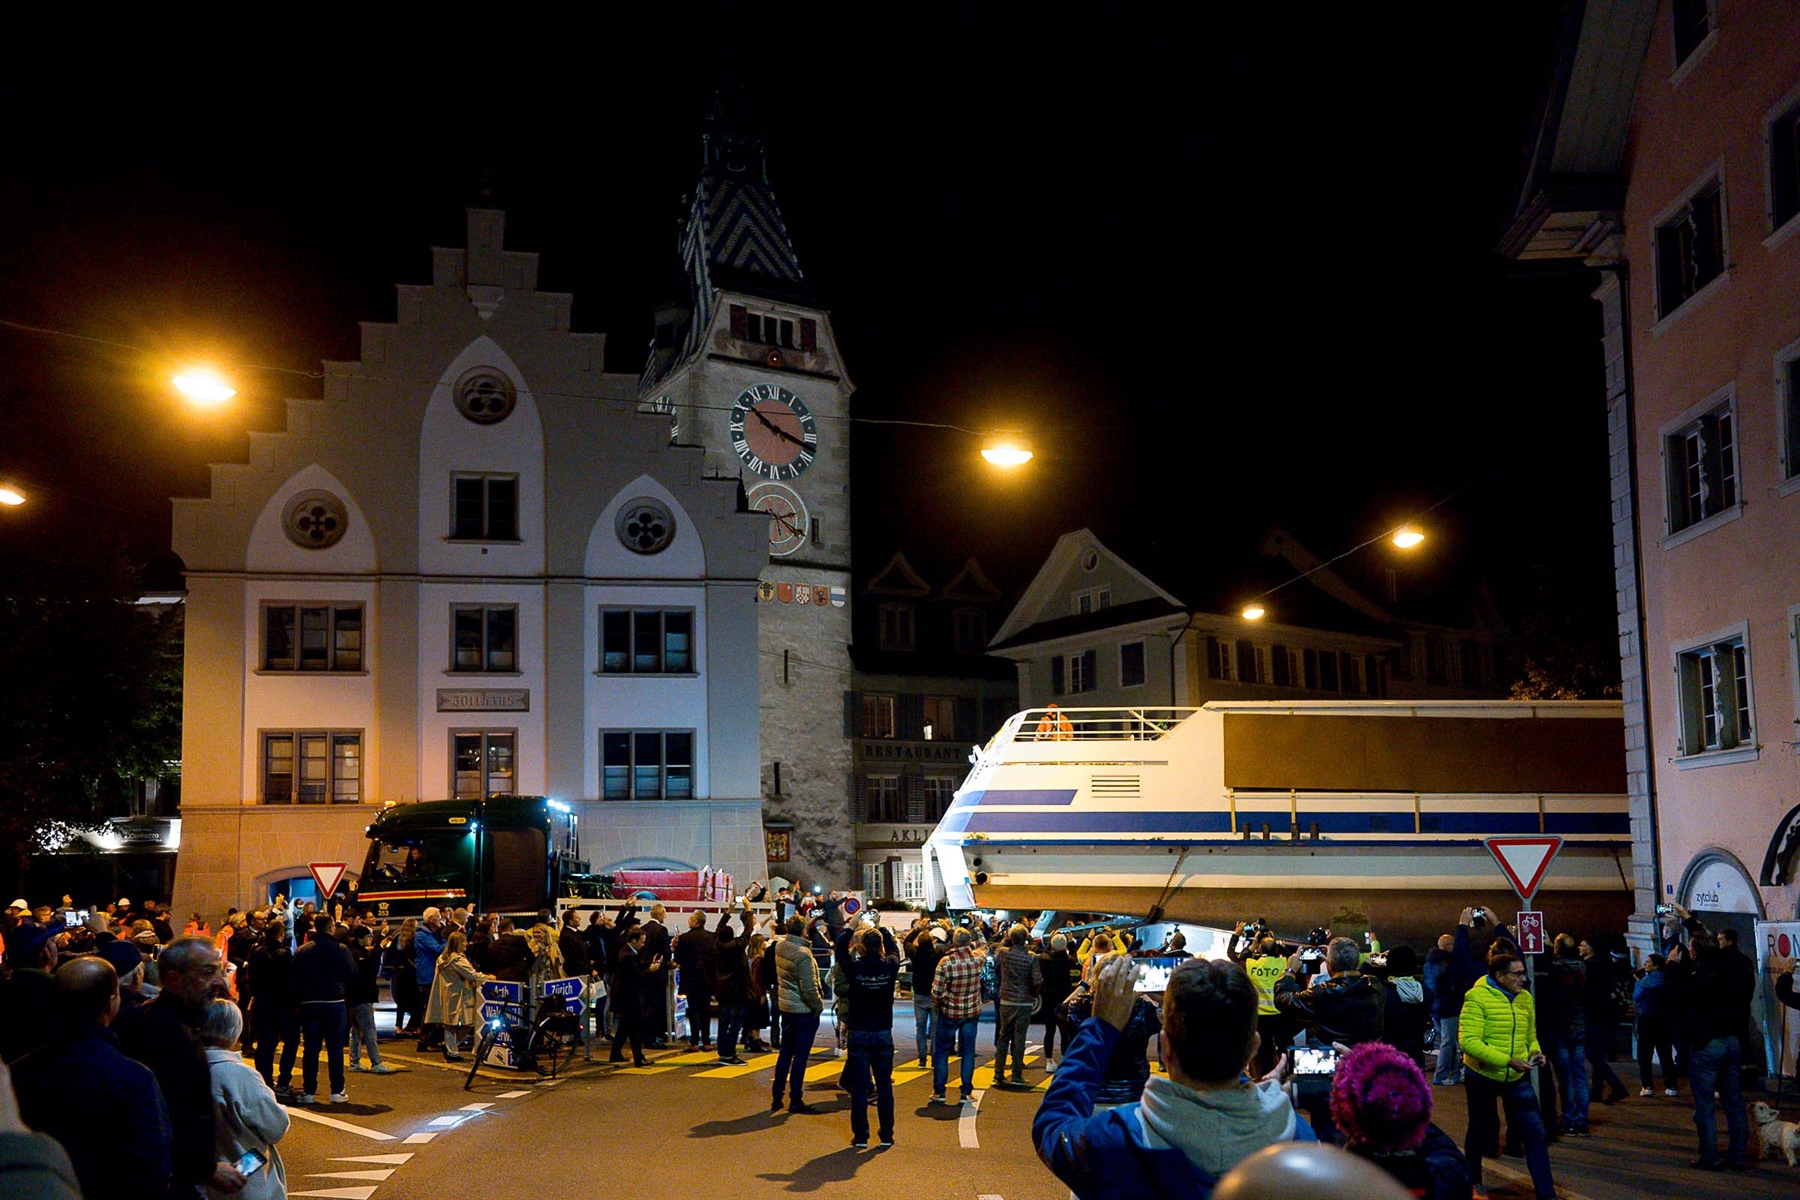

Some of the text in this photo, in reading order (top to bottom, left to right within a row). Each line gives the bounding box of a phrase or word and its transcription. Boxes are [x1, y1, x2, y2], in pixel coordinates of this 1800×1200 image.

[747, 386, 762, 403] XI
[766, 385, 780, 400] XII
[799, 412, 812, 423] II
[730, 420, 743, 432] IX
[804, 433, 817, 444] III
[733, 439, 750, 459] VIII
[747, 456, 763, 475] VII
[769, 465, 780, 480] VI
[788, 463, 799, 478] V
[865, 745, 961, 759] RESTAURANT
[891, 829, 934, 841] AKLI
[1250, 966, 1279, 977] FOTO
[551, 982, 573, 996] Zürich
